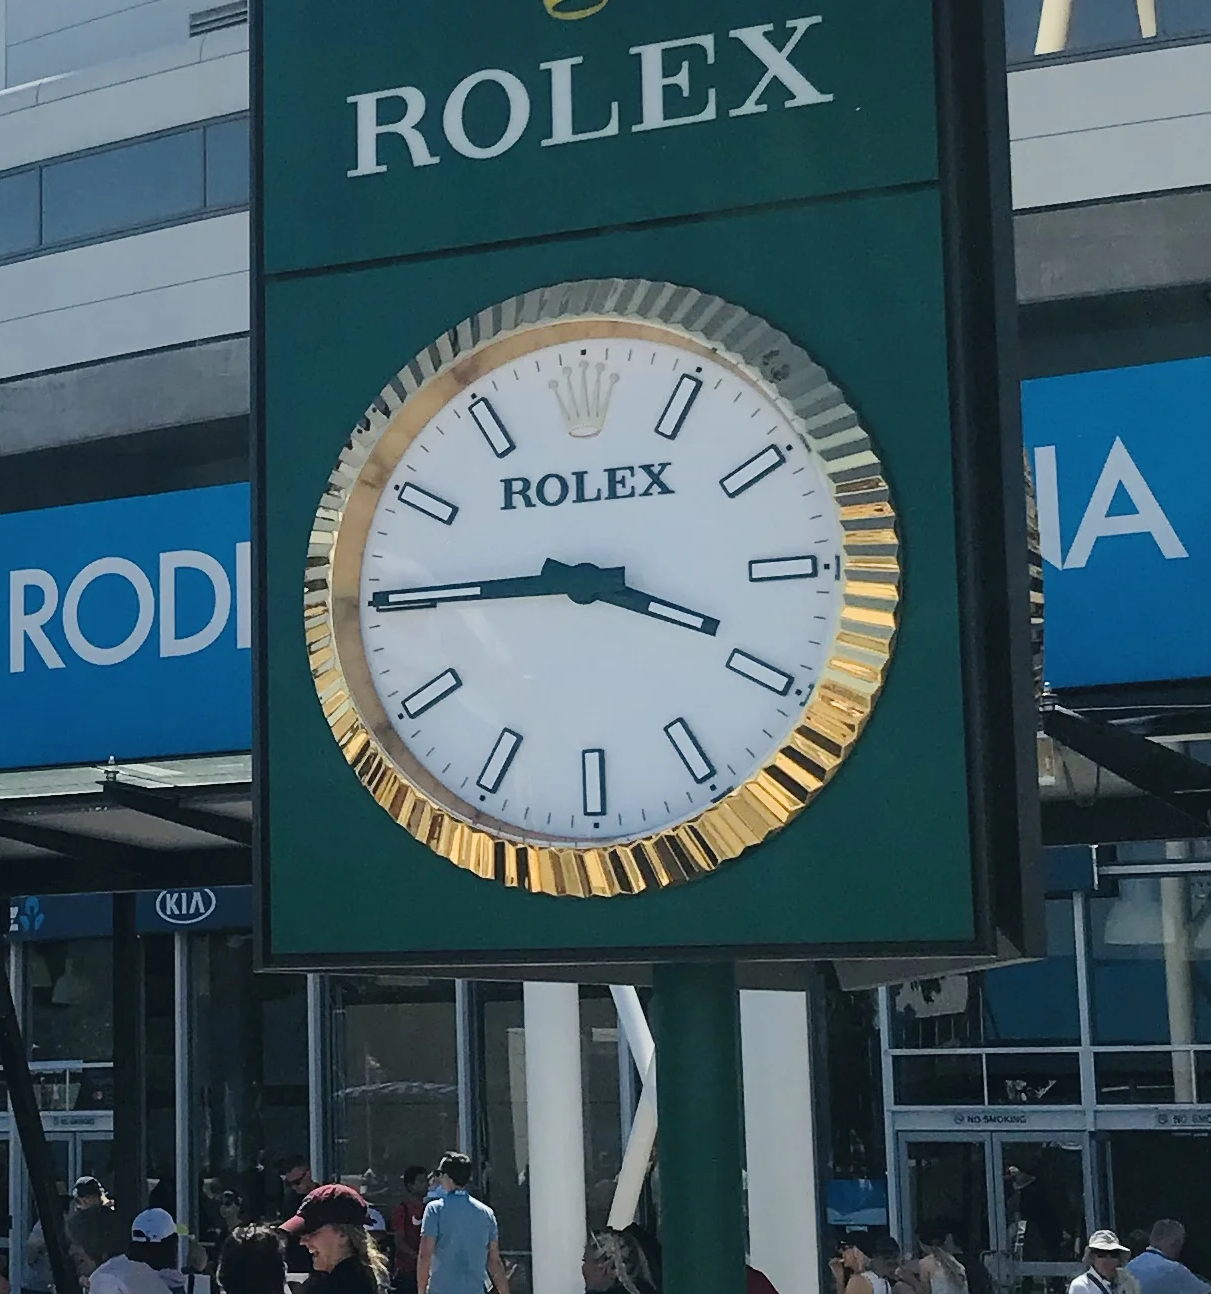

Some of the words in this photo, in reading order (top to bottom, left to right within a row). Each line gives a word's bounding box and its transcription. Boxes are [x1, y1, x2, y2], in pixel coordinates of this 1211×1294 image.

[346, 15, 834, 178] ROLEX
[500, 462, 676, 510] ROLEX
[165, 891, 206, 915] KIA
[967, 1115, 982, 1124] NO
[983, 1115, 1027, 1124] SMOKING
